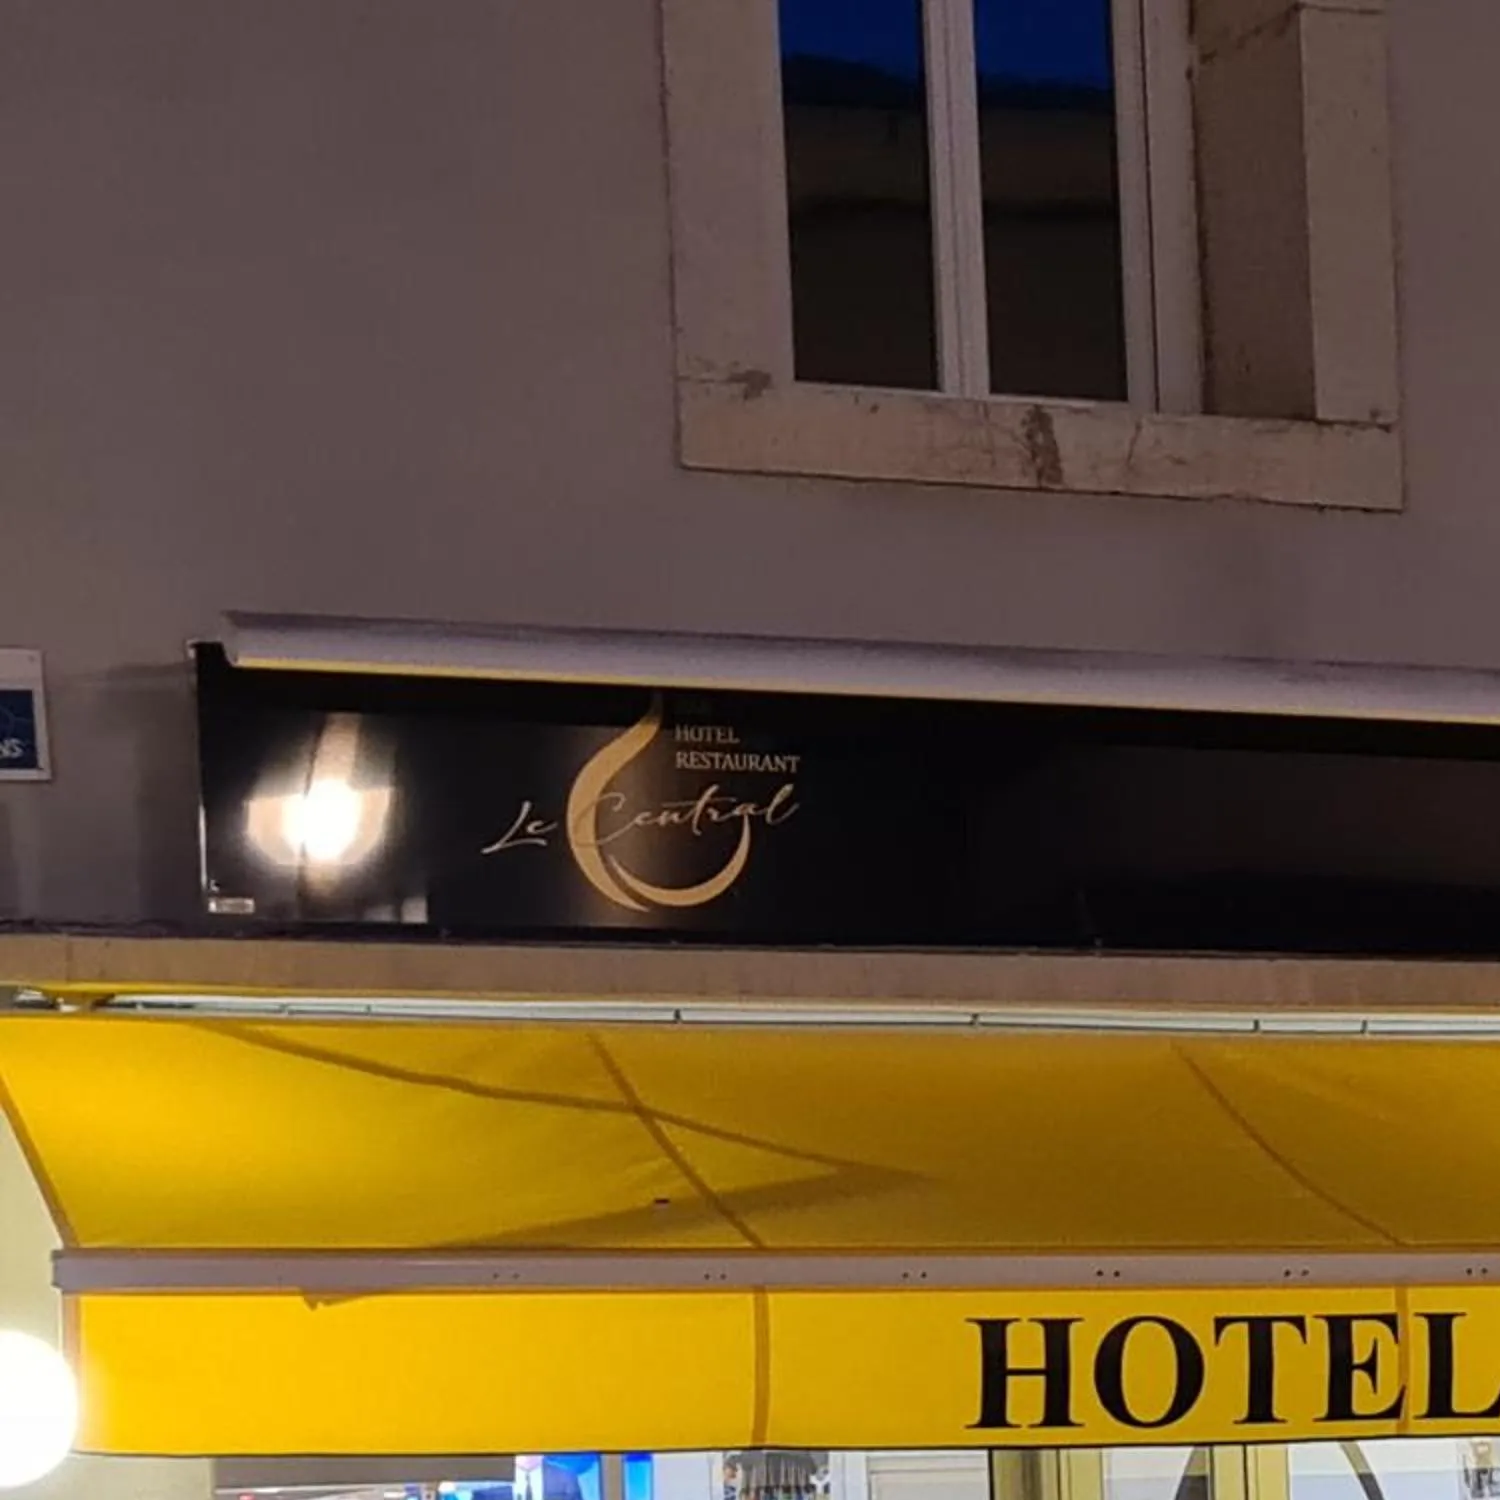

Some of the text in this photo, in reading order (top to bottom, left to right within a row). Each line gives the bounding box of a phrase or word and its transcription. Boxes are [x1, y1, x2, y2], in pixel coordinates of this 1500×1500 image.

[674, 724, 740, 744] HOTEL
[675, 750, 801, 774] RESTAURANT
[480, 783, 800, 854] Le Central
